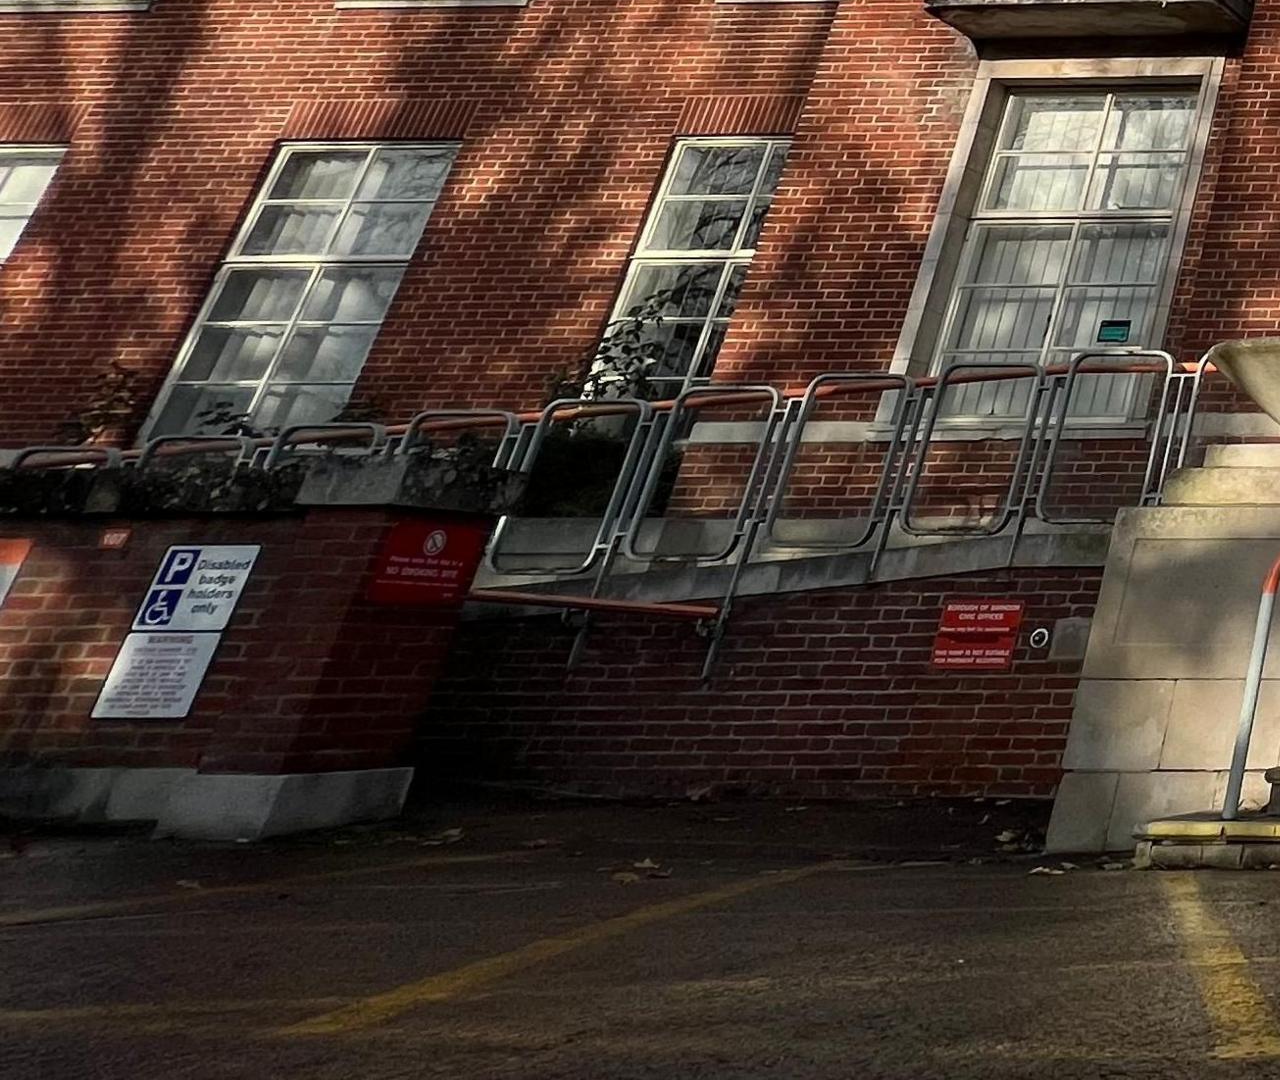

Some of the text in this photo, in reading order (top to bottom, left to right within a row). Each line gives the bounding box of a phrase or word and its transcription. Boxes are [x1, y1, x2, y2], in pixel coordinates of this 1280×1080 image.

[197, 559, 252, 571] Disabled
[198, 574, 236, 588] badge
[186, 588, 234, 600] holders
[191, 602, 218, 616] only
